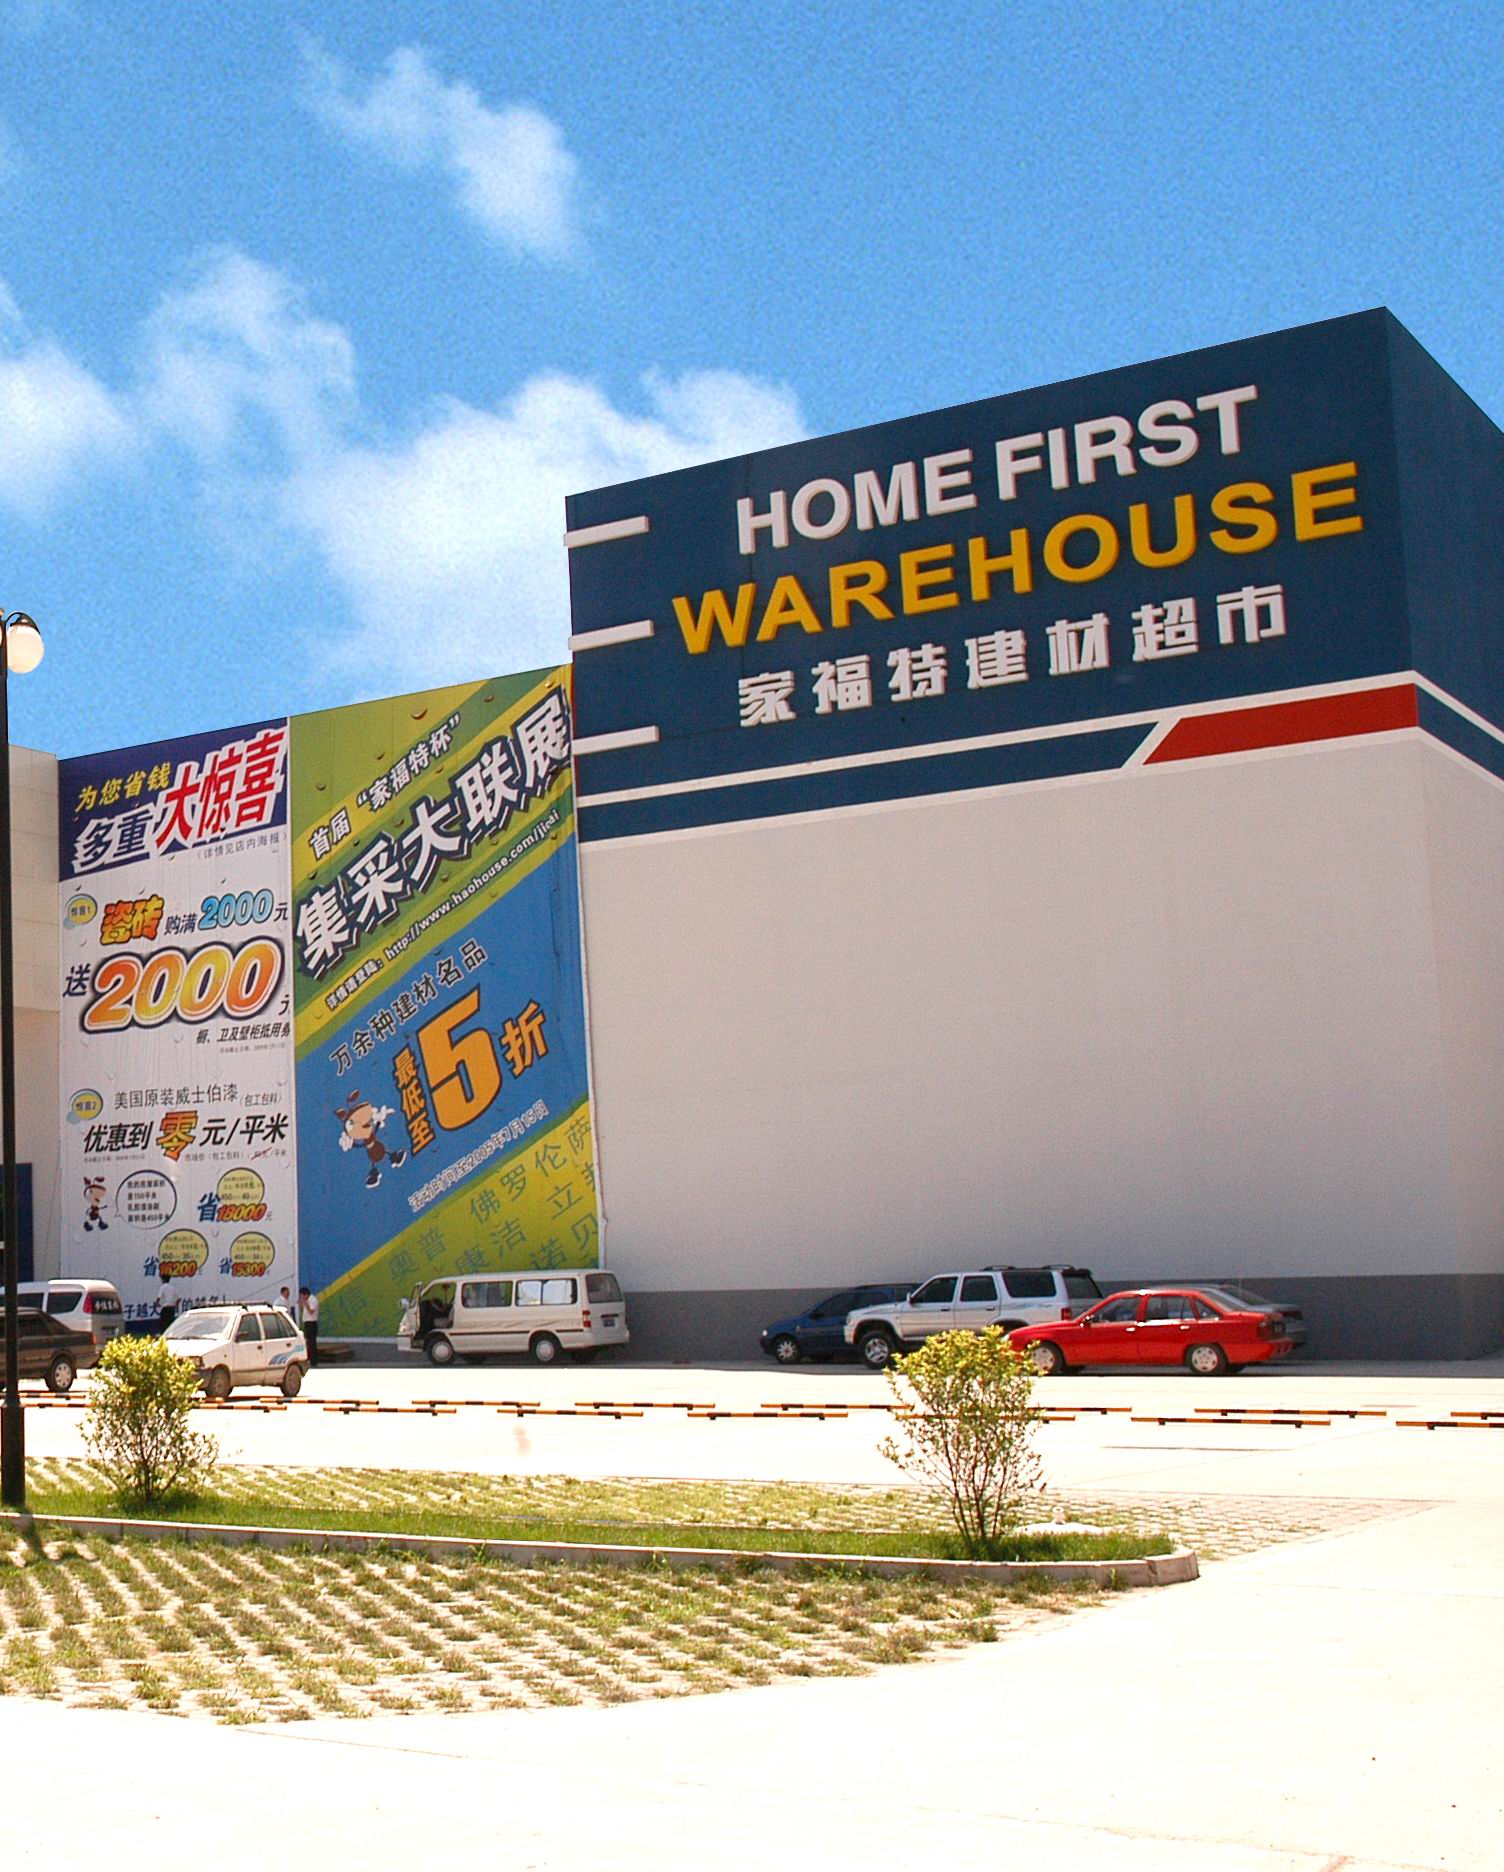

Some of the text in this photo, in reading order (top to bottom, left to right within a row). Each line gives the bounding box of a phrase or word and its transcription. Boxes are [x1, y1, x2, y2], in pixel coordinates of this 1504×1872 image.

[735, 384, 1258, 556] HOME FIRST
[671, 460, 1364, 656] WAREHOUSE
[737, 582, 1288, 729] 家福特建材超市
[74, 761, 171, 813] 为您省钱
[154, 727, 287, 850] 大惊喜
[295, 686, 572, 975] 集采大联展
[309, 807, 352, 860] 首届
[100, 888, 289, 946] 瓷砖 购满 2000 元
[63, 963, 92, 998] 送
[80, 935, 285, 1034] 2000
[329, 938, 488, 1076] 万余种建材名品
[114, 1083, 239, 1110] 美国原装威士伯漆
[392, 983, 549, 1157] 最低至 5 折
[83, 1110, 289, 1162] 优惠到 零 元/平米
[198, 1191, 221, 1222] 省
